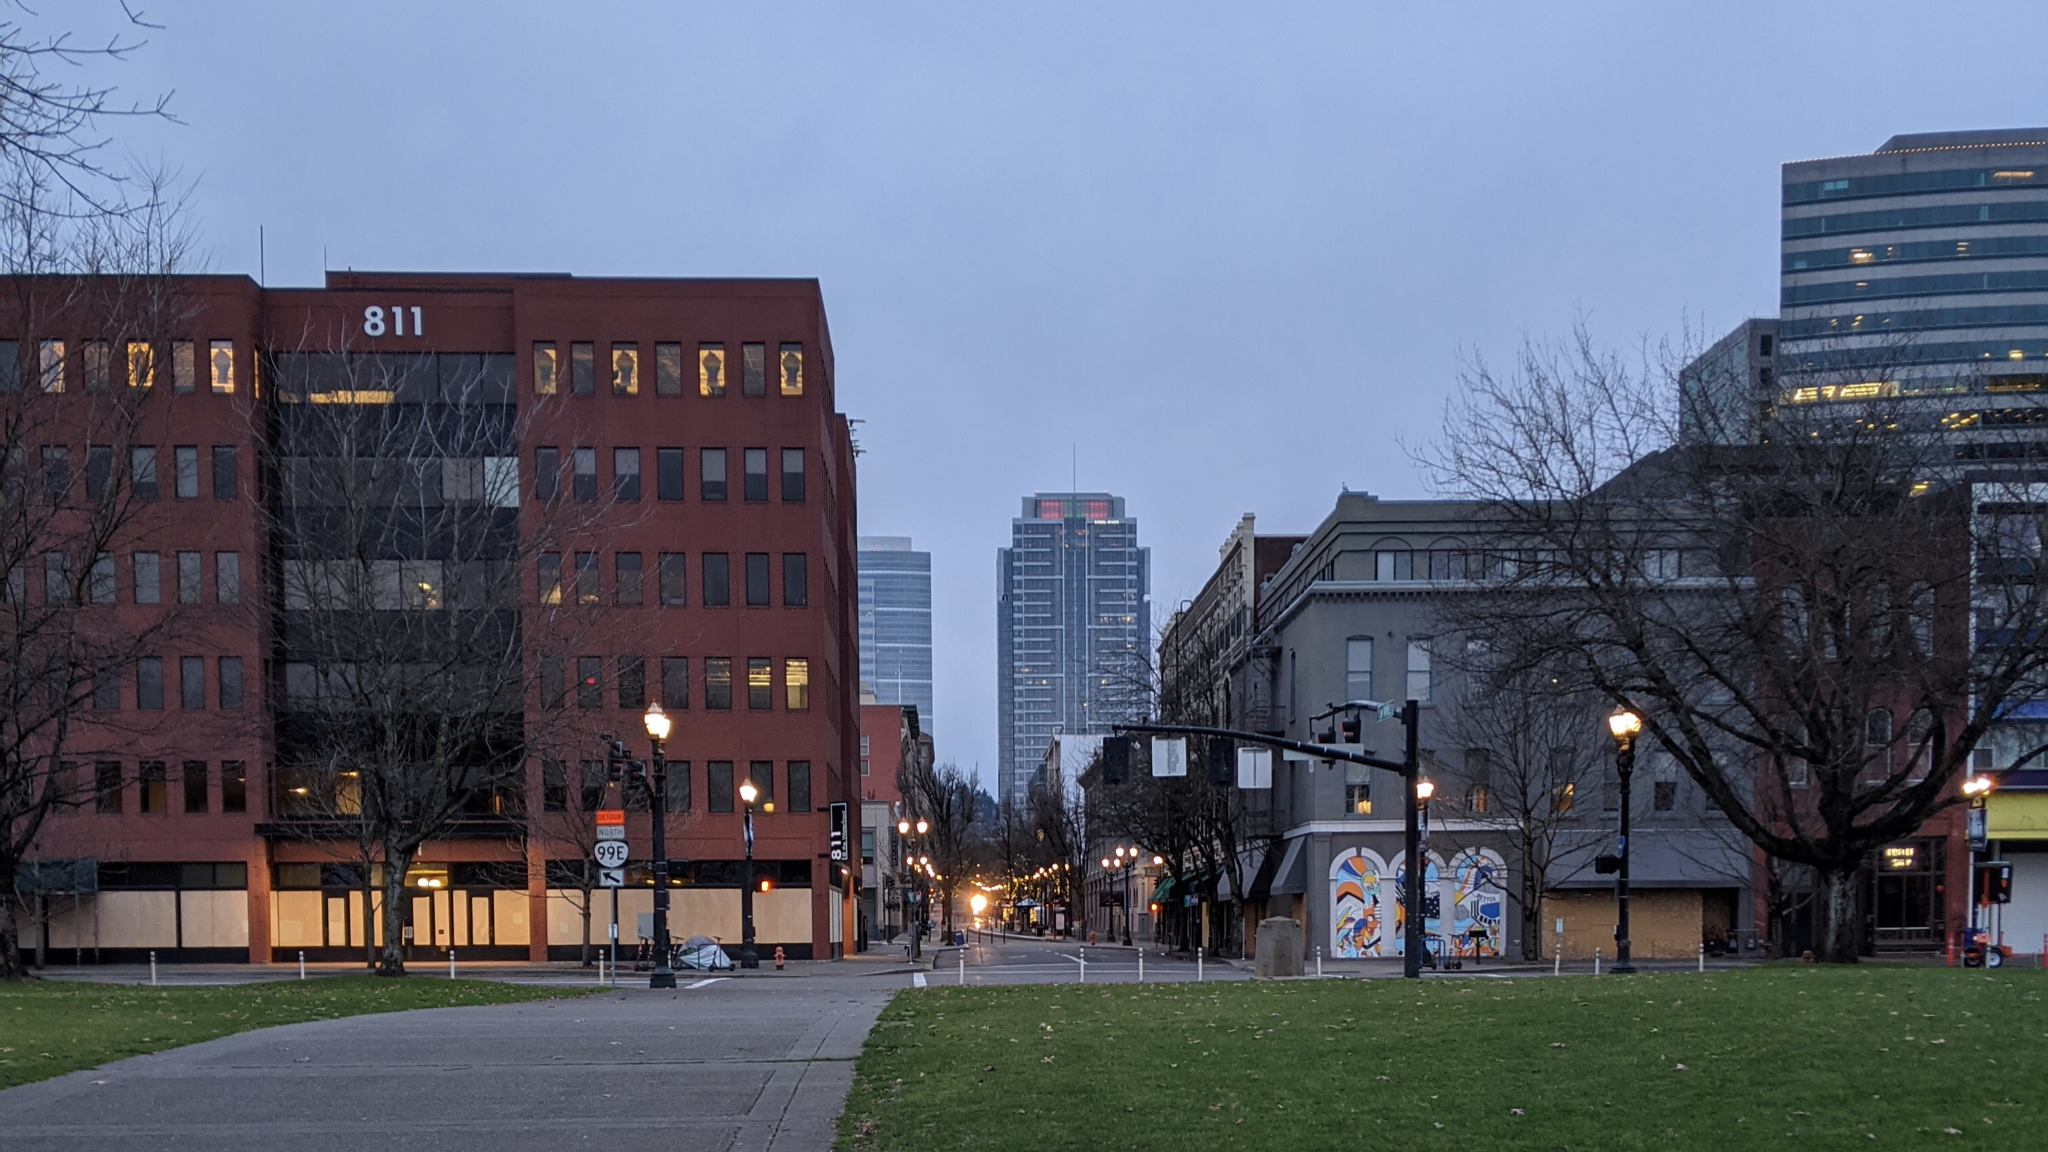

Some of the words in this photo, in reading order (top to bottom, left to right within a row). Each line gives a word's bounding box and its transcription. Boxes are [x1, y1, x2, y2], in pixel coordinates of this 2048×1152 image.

[364, 305, 422, 336] 811
[598, 813, 622, 821] DETOUR
[598, 828, 623, 836] NORTH
[830, 831, 842, 860] 811
[597, 846, 624, 860] 99E
